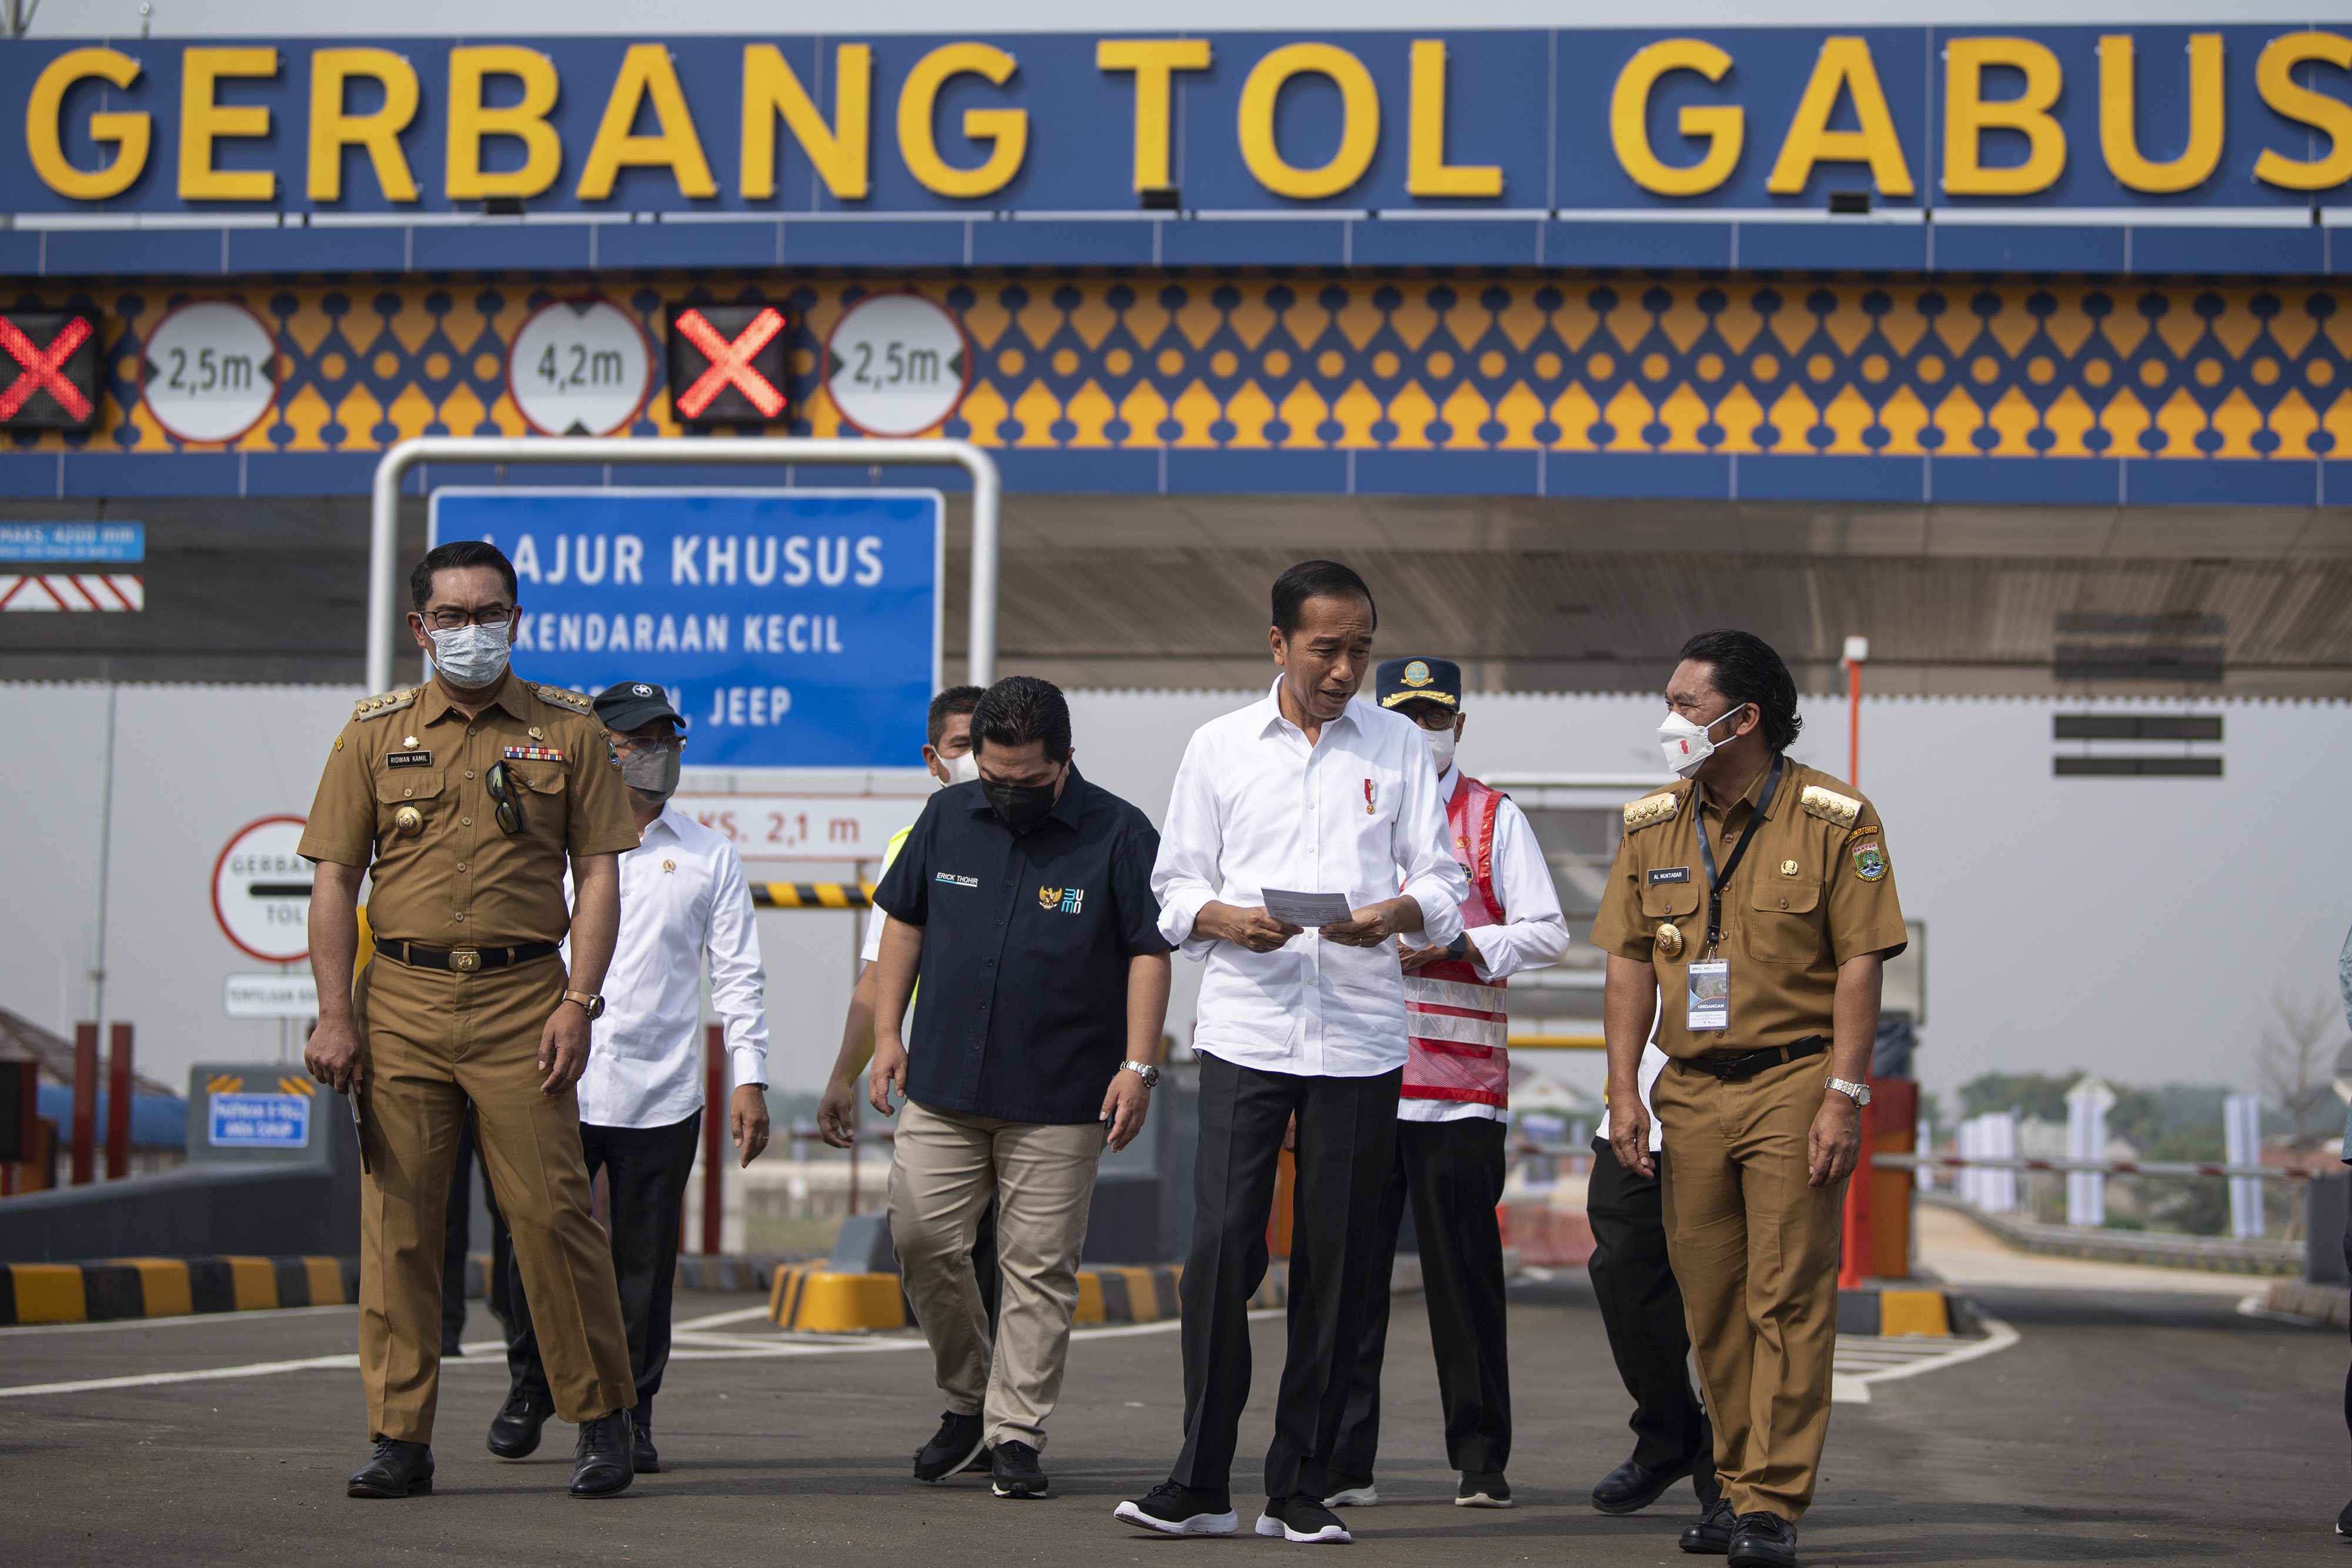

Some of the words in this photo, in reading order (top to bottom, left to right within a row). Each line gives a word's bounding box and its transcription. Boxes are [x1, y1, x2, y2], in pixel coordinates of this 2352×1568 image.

[26, 42, 1027, 199] GERBANG
[1097, 40, 1503, 196] TOL
[1610, 31, 2352, 194] GABUS
[168, 345, 253, 399] 2,5m
[537, 342, 623, 391] 4,2m
[853, 340, 939, 388] 2,5m
[482, 533, 644, 585] AJUR
[670, 534, 883, 587] KHUSUS
[515, 612, 729, 652] KENDARAAN
[743, 613, 843, 654] KECIL
[708, 687, 791, 727] JEEP
[766, 811, 808, 848] 2,1
[827, 817, 860, 842] m
[1853, 843, 1876, 853] BANTEN
[1857, 827, 1877, 835] BANTEN
[937, 872, 956, 881] ERICK
[957, 875, 978, 885] THOHIR
[266, 904, 305, 925] TOL
